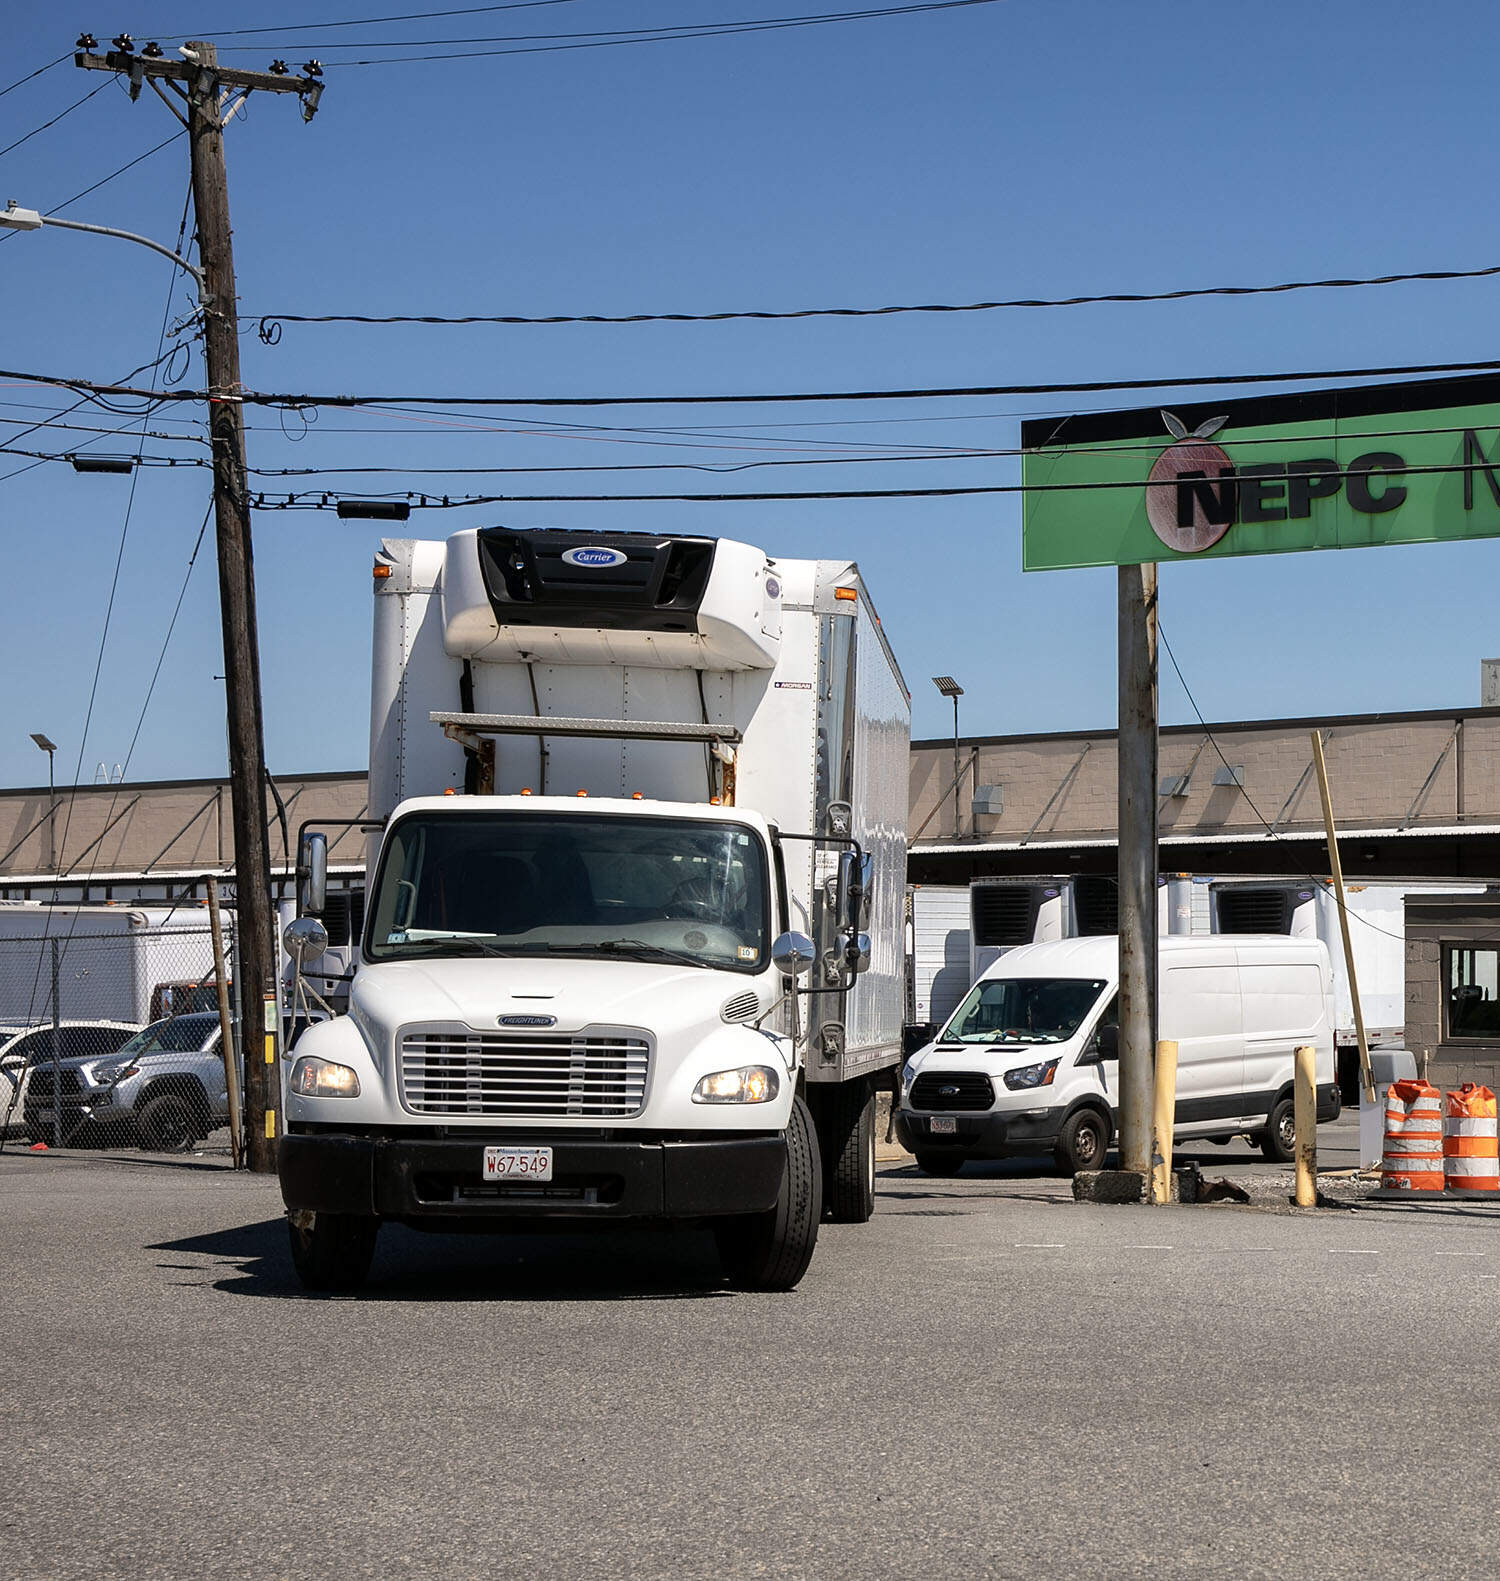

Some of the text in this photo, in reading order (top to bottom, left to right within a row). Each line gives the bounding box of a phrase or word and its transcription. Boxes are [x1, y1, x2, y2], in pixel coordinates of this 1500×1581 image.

[1176, 451, 1408, 528] NEPC
[577, 552, 612, 562] Carrier
[504, 1017, 550, 1025] FREIGHTLINER
